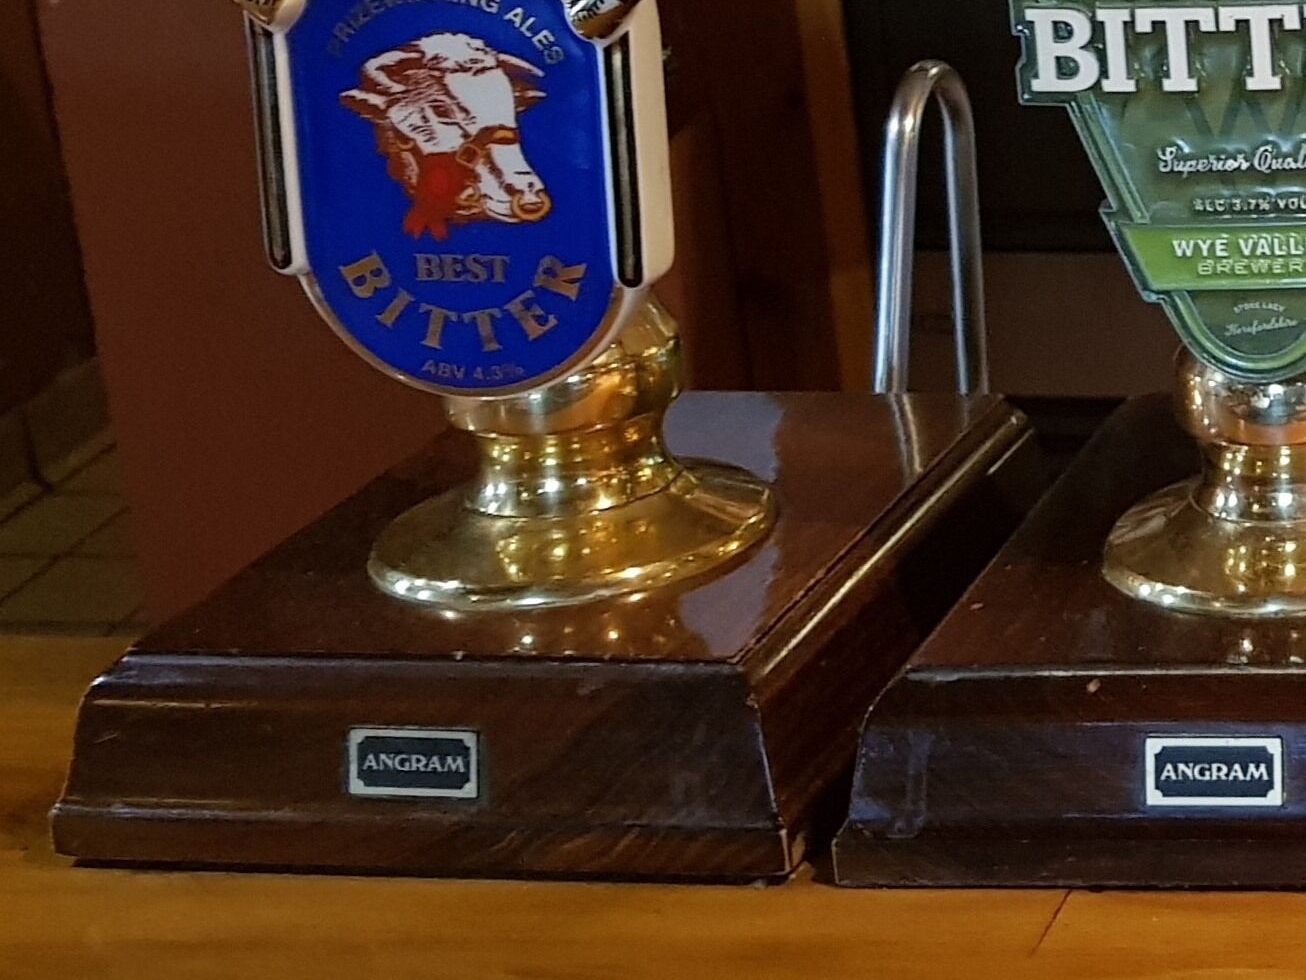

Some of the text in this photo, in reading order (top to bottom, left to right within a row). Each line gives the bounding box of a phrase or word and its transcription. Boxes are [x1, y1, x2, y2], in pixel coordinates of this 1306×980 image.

[503, 6, 566, 66] ALES
[1157, 146, 1250, 178] Superior
[1231, 197, 1271, 211] 3.7%
[1171, 237, 1230, 258] WYE
[413, 252, 511, 283] BEST
[338, 248, 588, 352] BITTER
[421, 359, 466, 380] ABV
[362, 752, 466, 773] ANGRAM
[1160, 762, 1270, 781] ANGRAM
